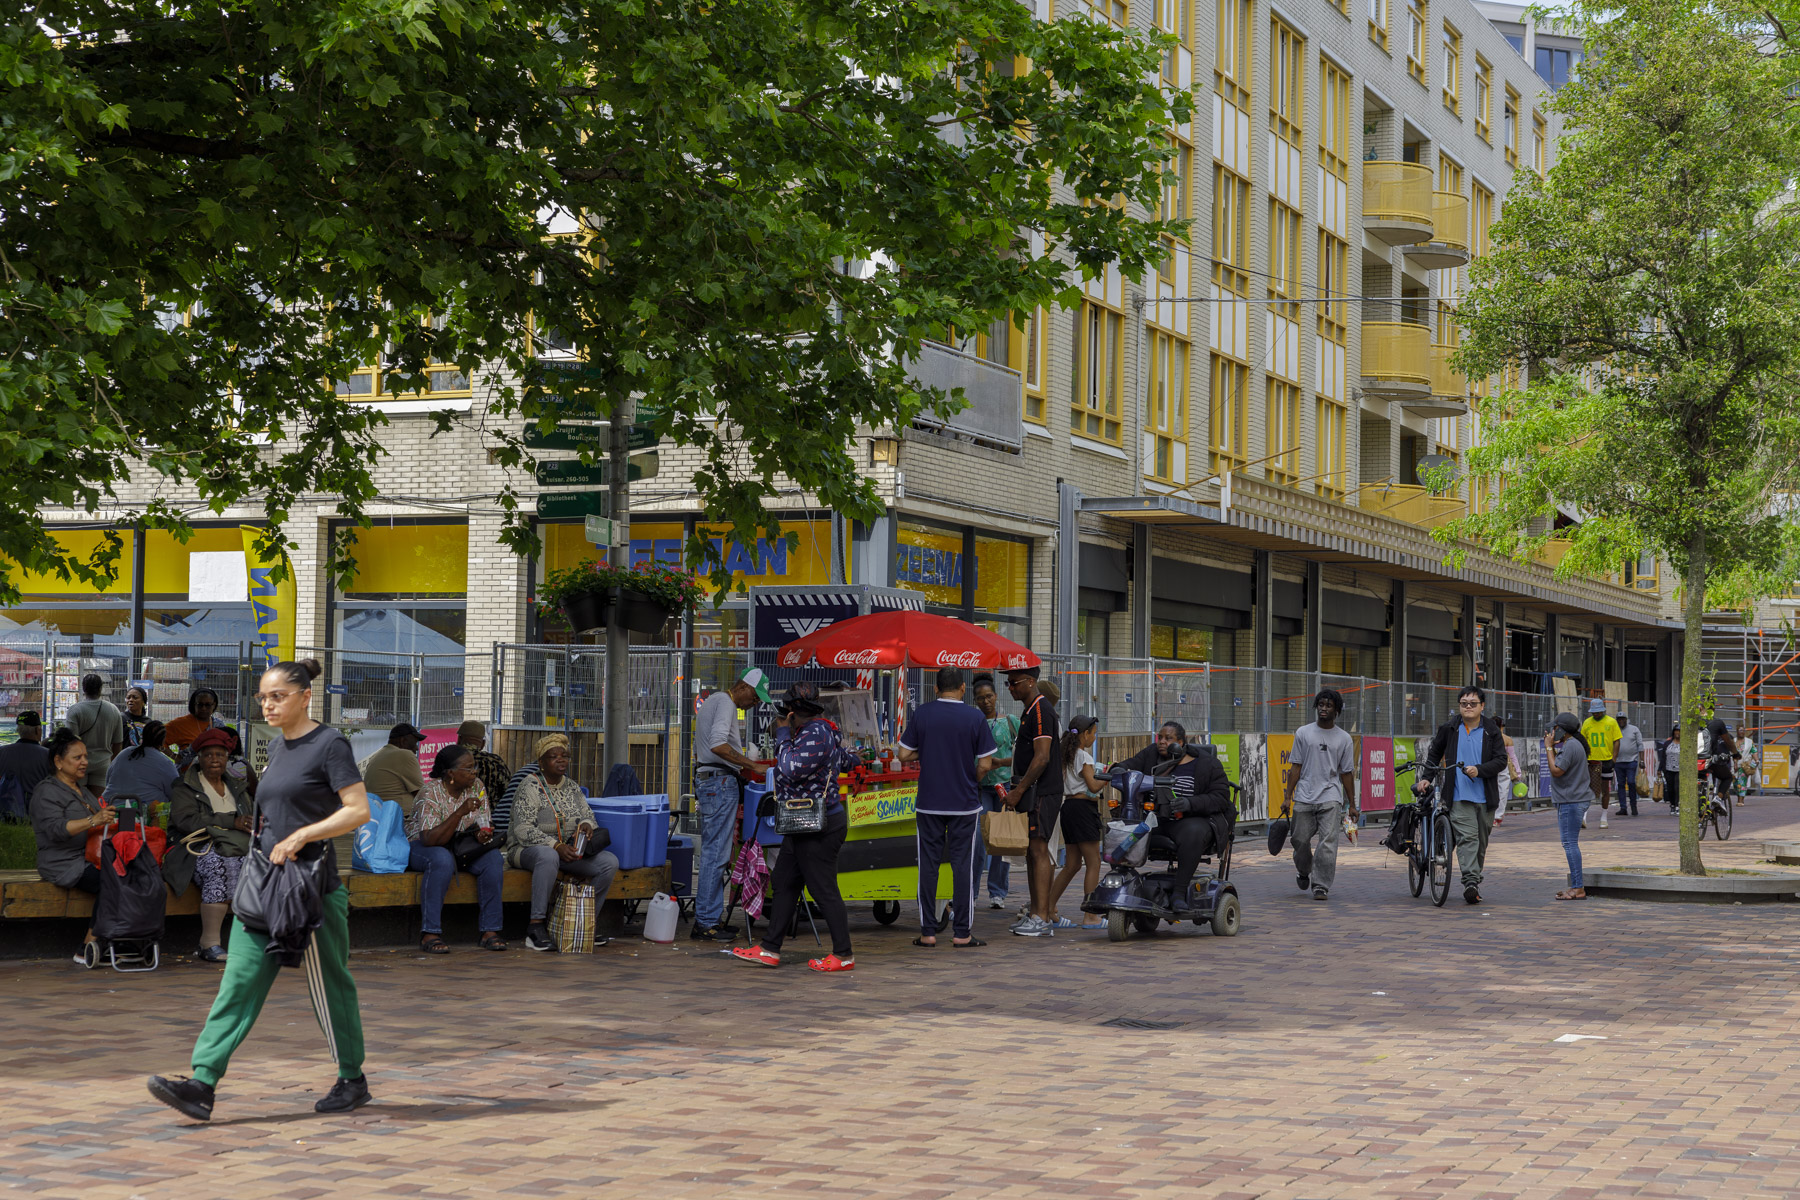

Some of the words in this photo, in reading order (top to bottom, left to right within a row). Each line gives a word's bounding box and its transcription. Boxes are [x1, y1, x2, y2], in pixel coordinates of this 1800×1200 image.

[556, 428, 576, 437] Cruijff
[566, 475, 589, 483] 260-505
[896, 543, 979, 591] ZEEMA
[834, 649, 882, 665] Coca-Cola
[936, 650, 982, 667] Coca-Cola
[1591, 733, 1606, 747] 01
[420, 743, 436, 754] WIST
